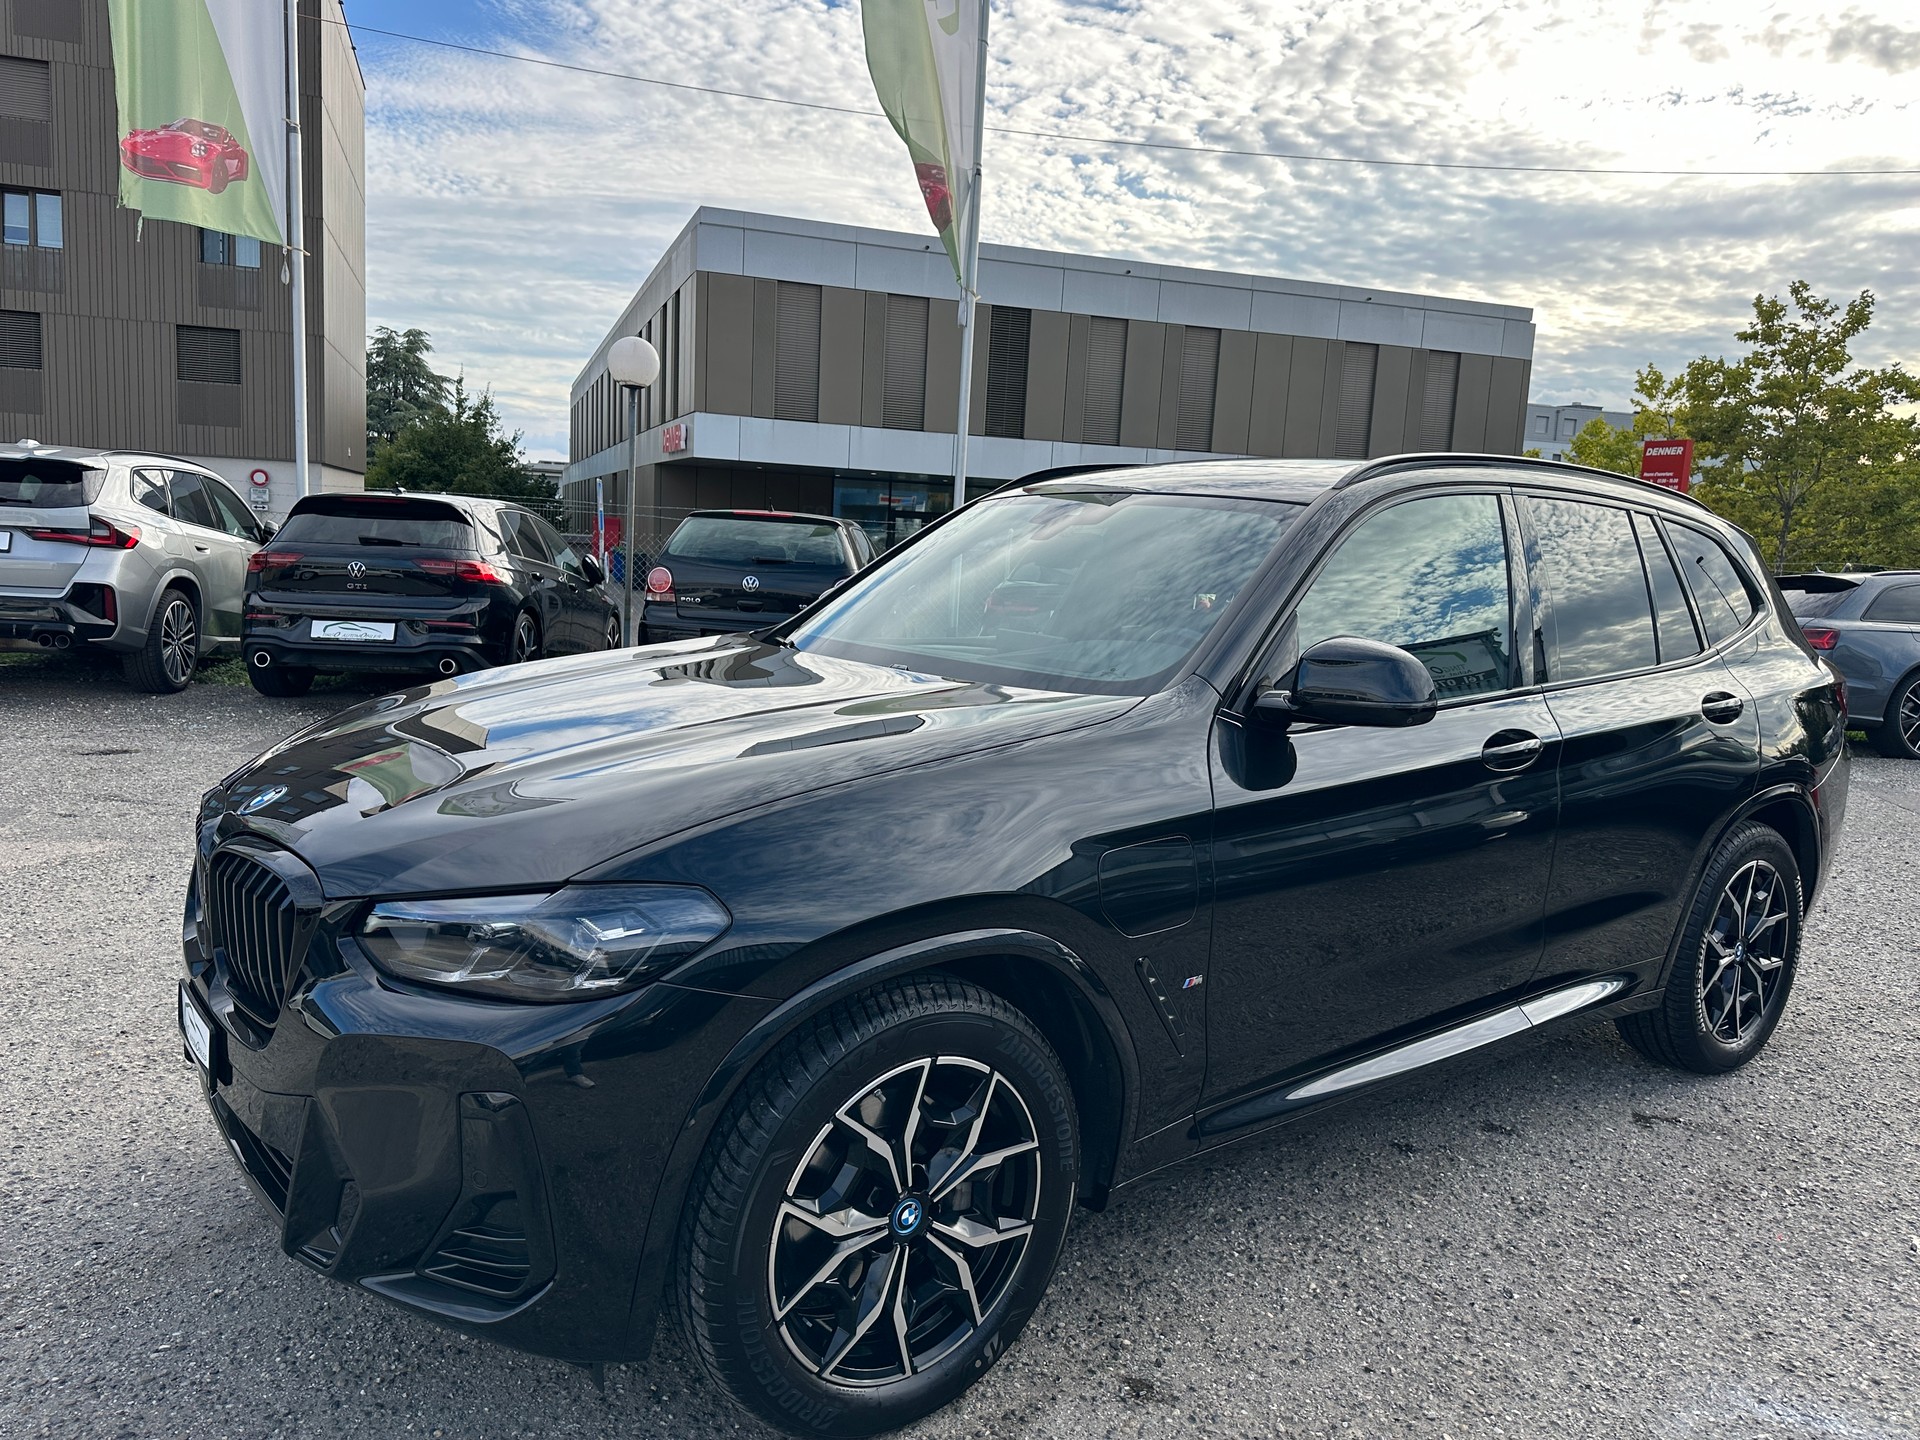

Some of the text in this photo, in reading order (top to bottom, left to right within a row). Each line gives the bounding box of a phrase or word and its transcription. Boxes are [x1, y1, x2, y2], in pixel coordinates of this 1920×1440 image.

[1645, 446, 1684, 456] DENNER
[995, 1029, 1075, 1172] BRIDGESTONE
[735, 1288, 842, 1431] BRIDGESTONE
